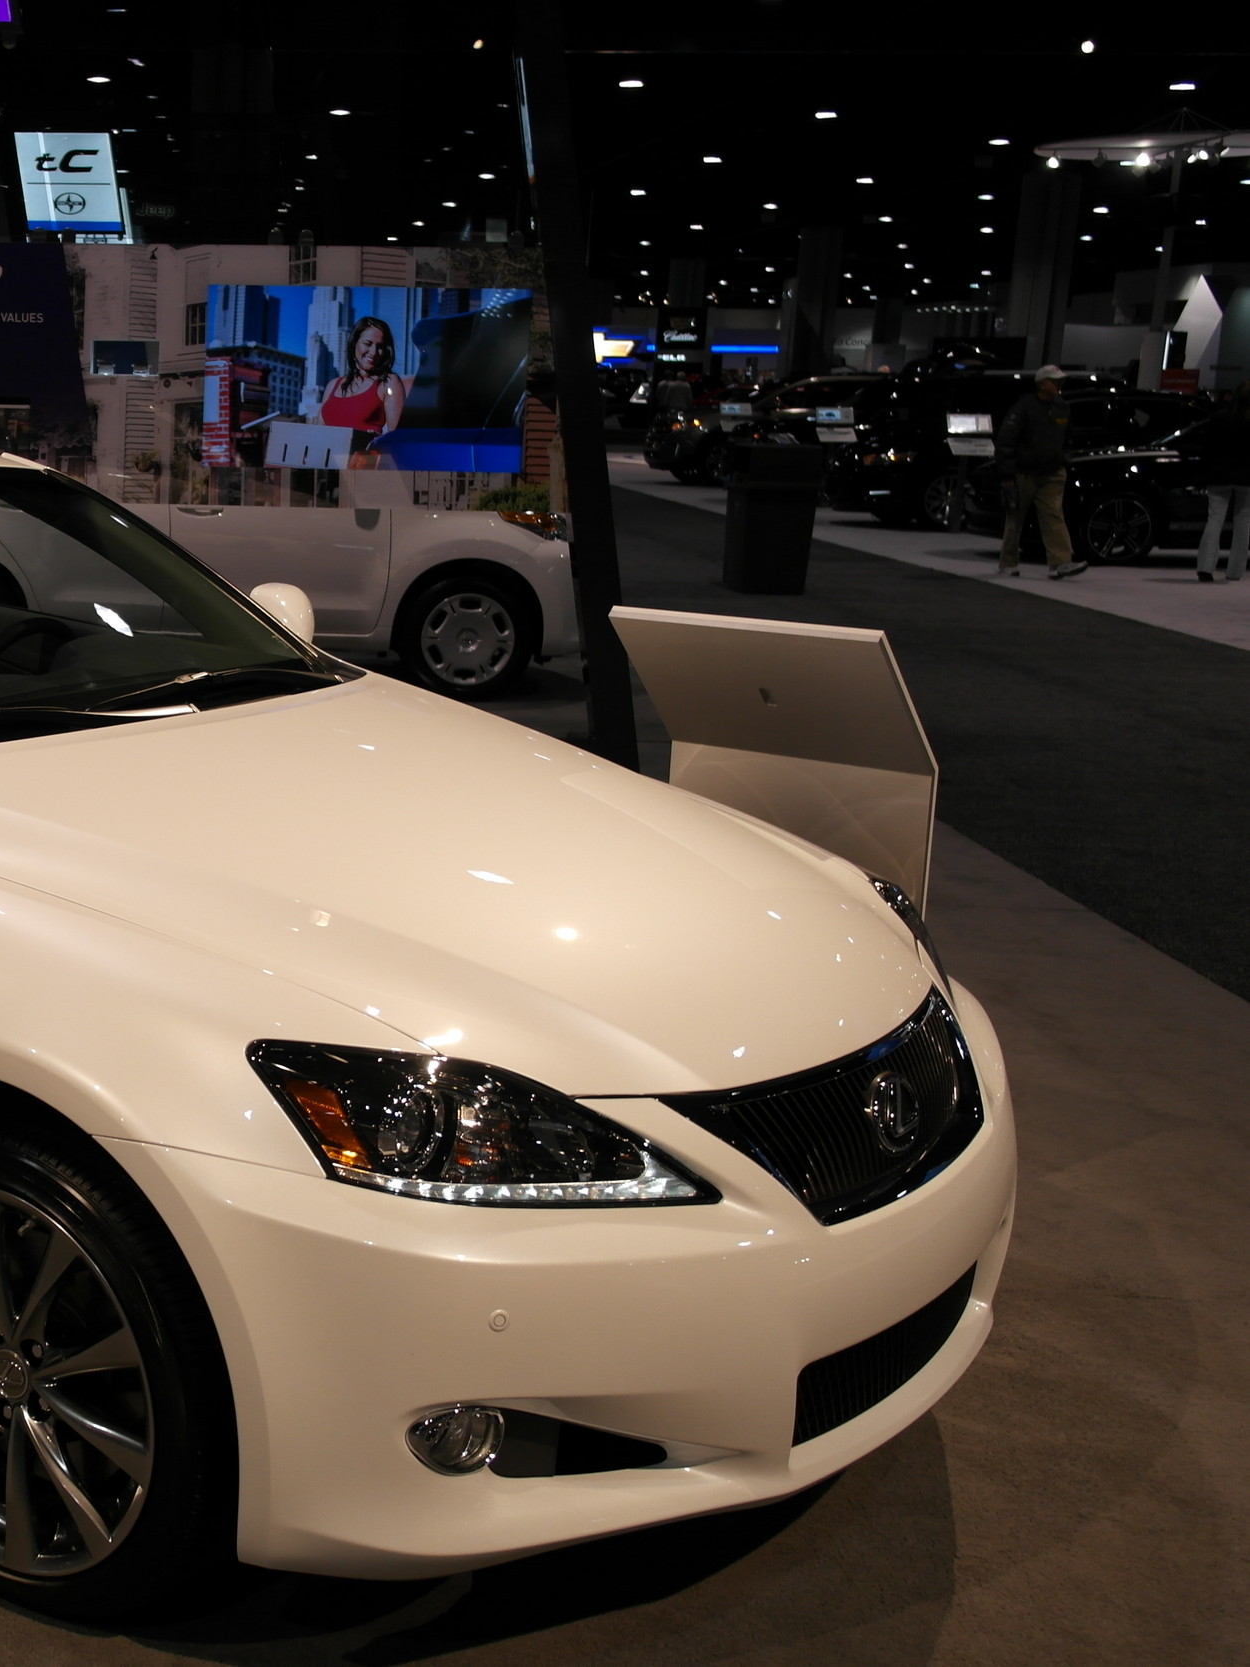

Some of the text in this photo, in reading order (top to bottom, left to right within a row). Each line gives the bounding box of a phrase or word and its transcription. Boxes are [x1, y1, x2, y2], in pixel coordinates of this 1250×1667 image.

[34, 149, 99, 173] tC
[136, 201, 175, 219] Jeep
[1, 312, 44, 323] VALUES
